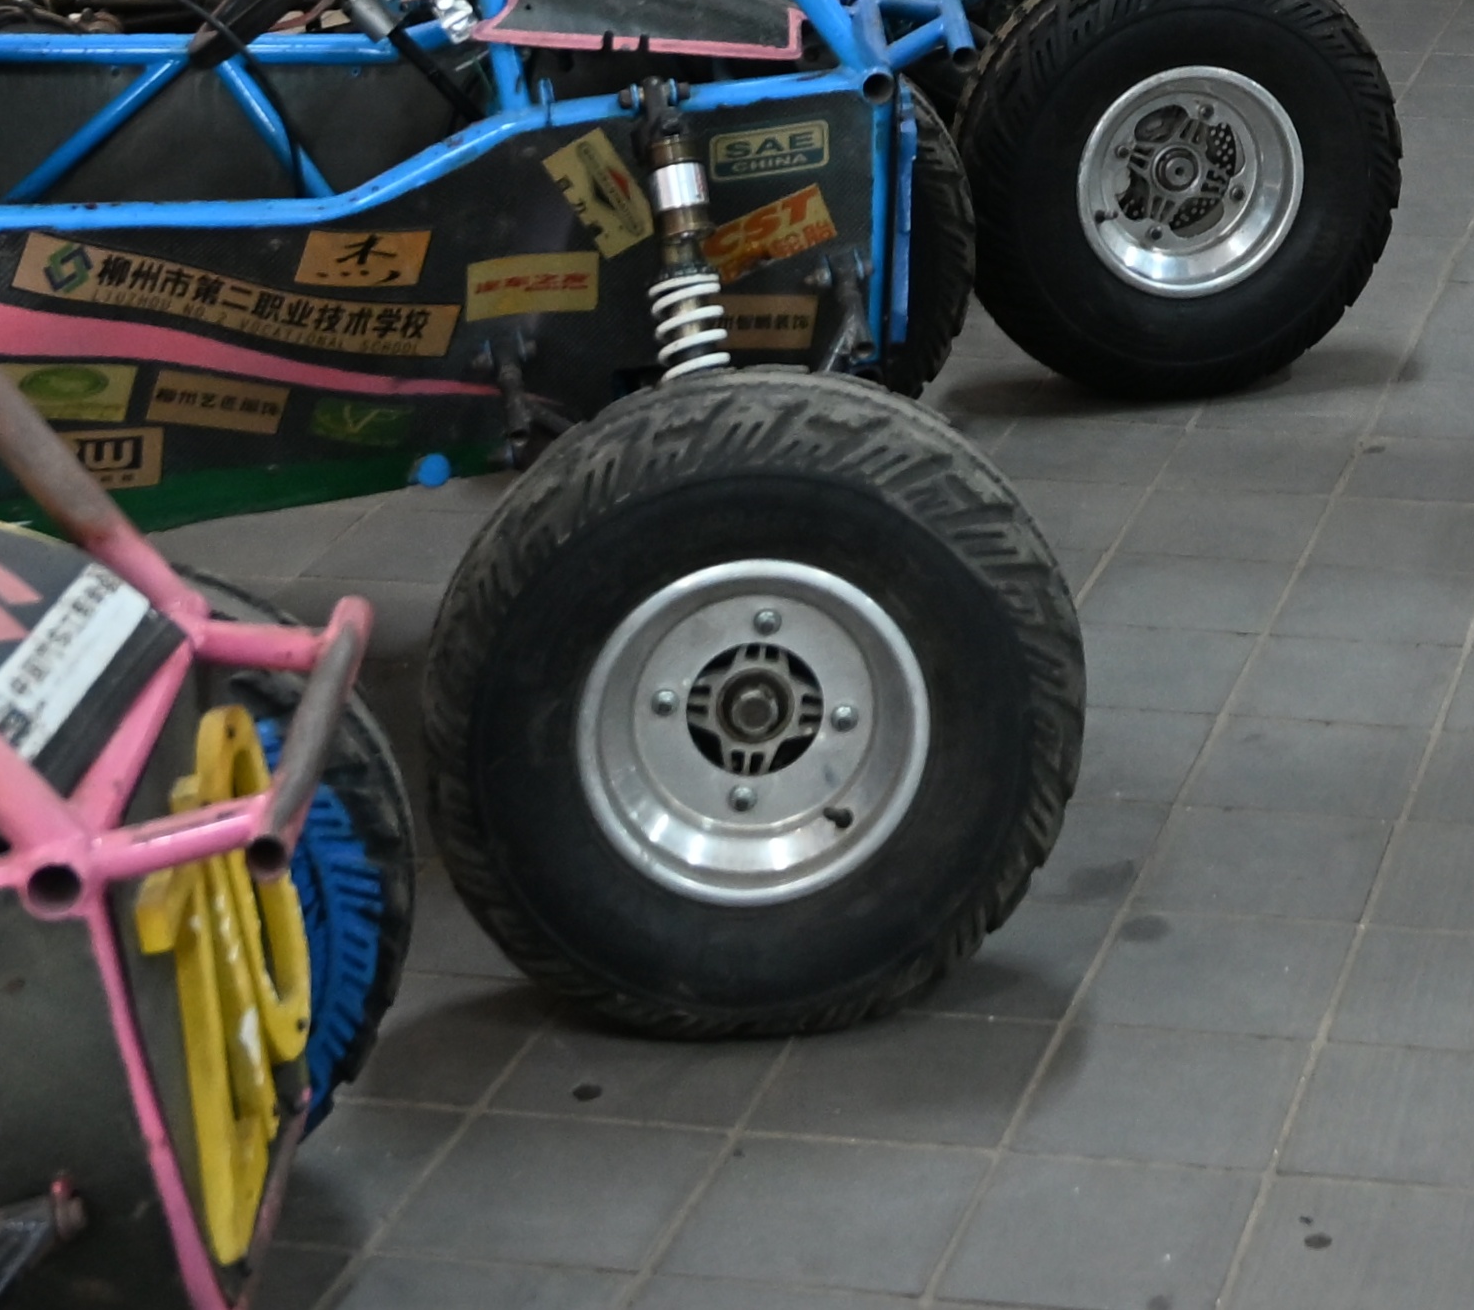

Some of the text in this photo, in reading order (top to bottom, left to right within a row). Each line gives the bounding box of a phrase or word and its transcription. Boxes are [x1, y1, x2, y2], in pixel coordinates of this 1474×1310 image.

[723, 131, 816, 161] SAE
[729, 153, 810, 175] CHINA
[701, 186, 820, 260] CST
[97, 252, 432, 342] 柳州市第二职业技术学校
